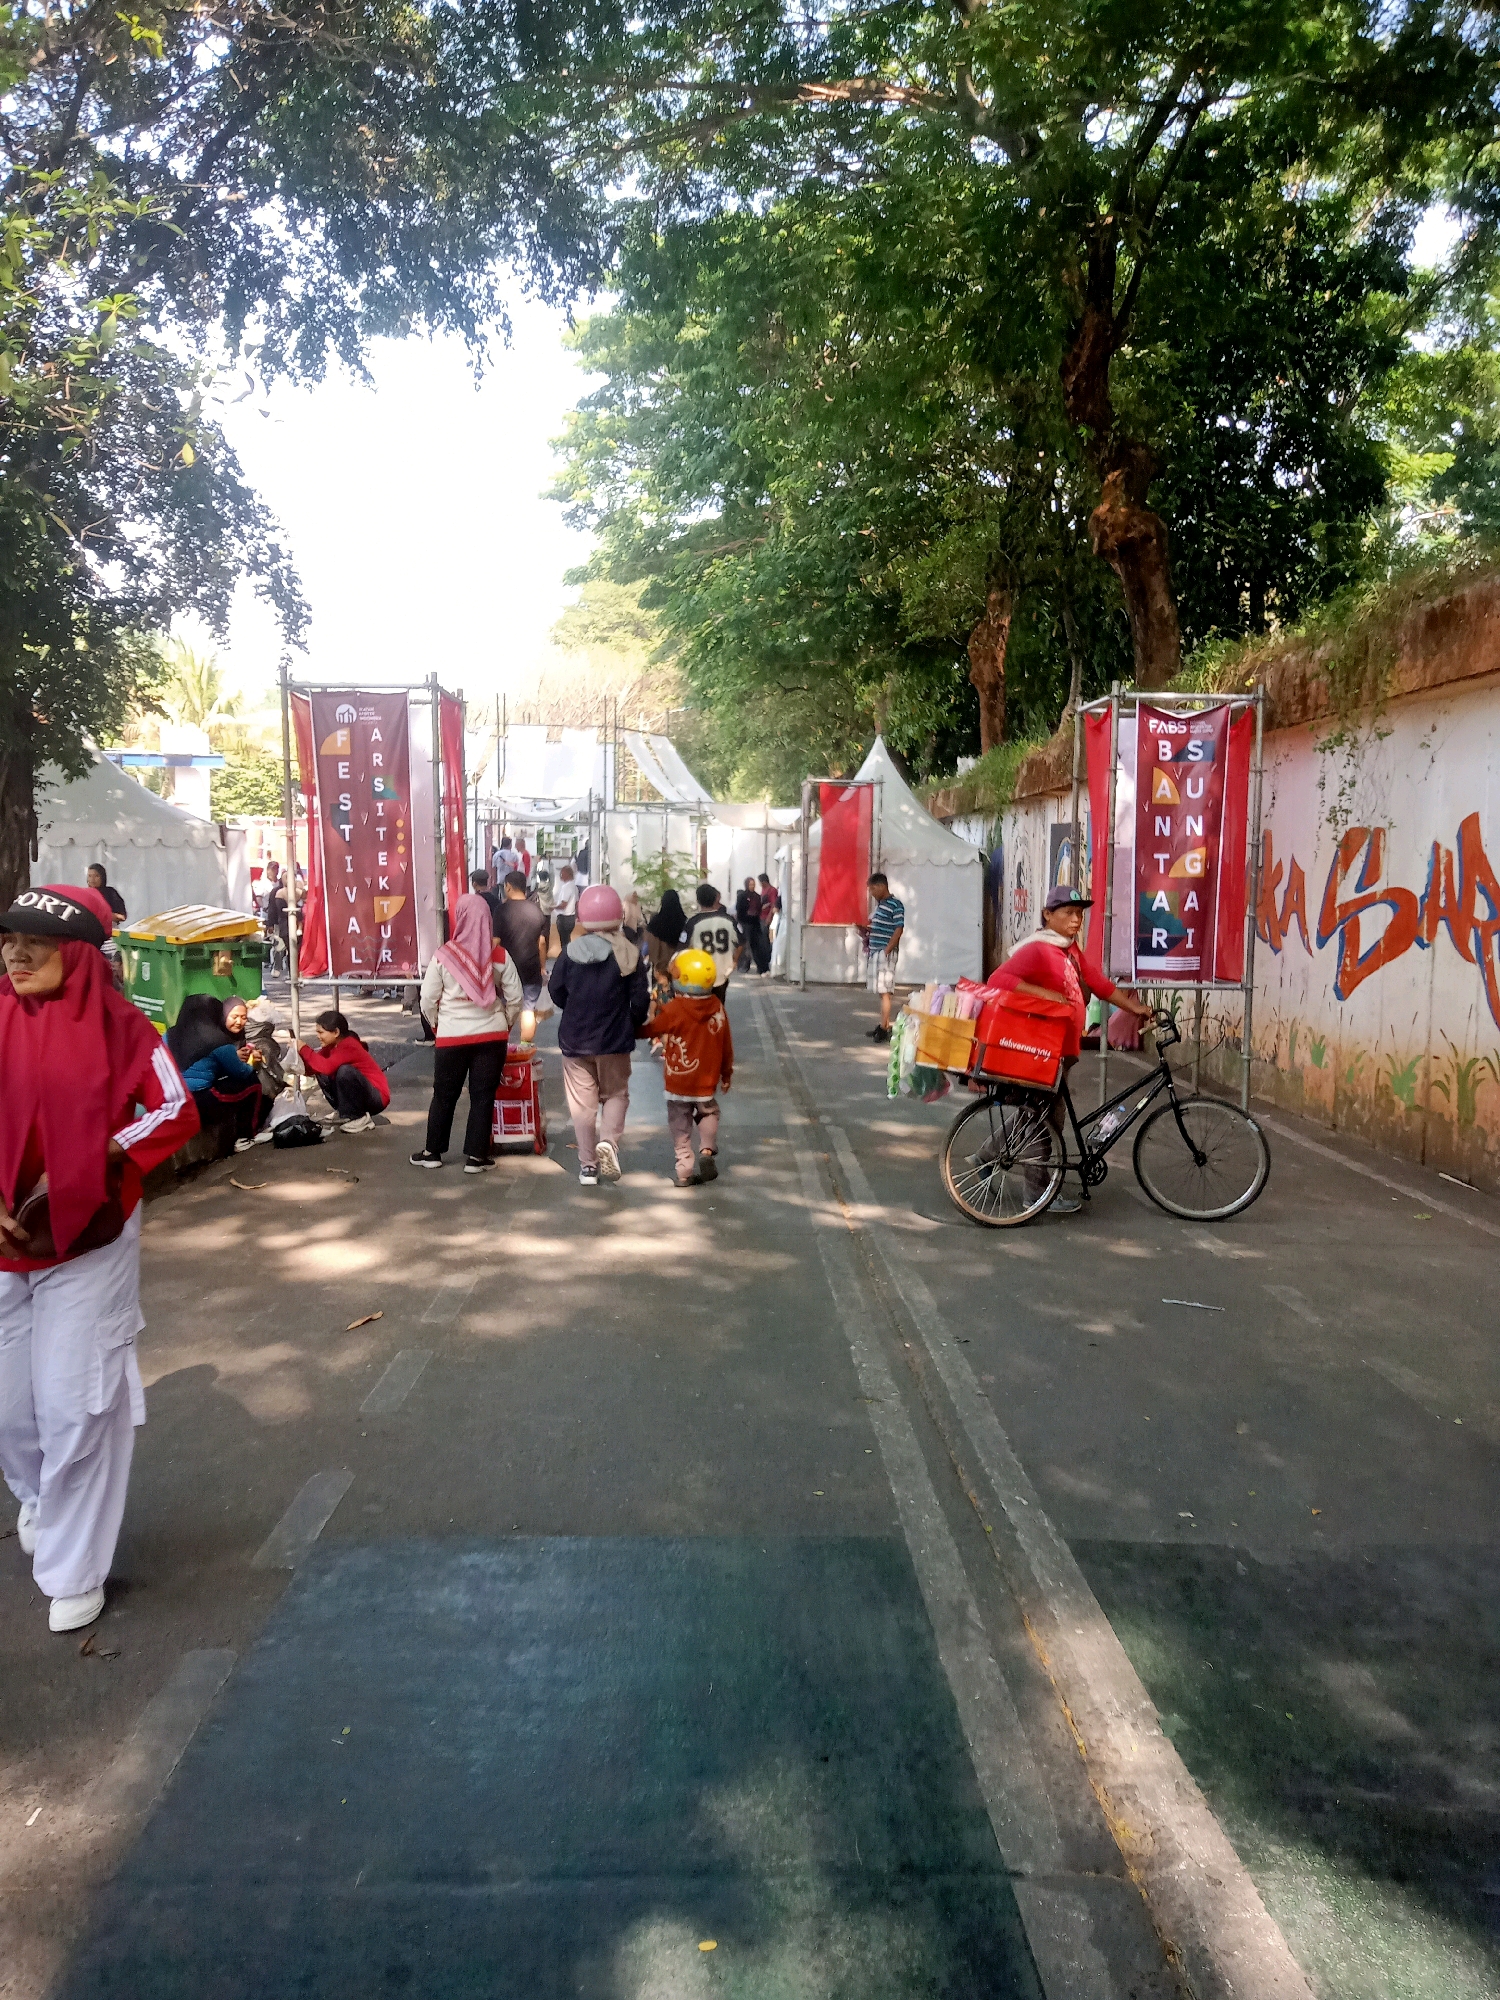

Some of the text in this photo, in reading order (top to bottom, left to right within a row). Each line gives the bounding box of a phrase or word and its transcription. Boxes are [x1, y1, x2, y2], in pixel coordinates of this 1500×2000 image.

[1149, 718, 1187, 735] FABS
[336, 729, 363, 964] FESTIVAL
[370, 727, 393, 963] ARSITEKTUR
[700, 928, 729, 955] 89
